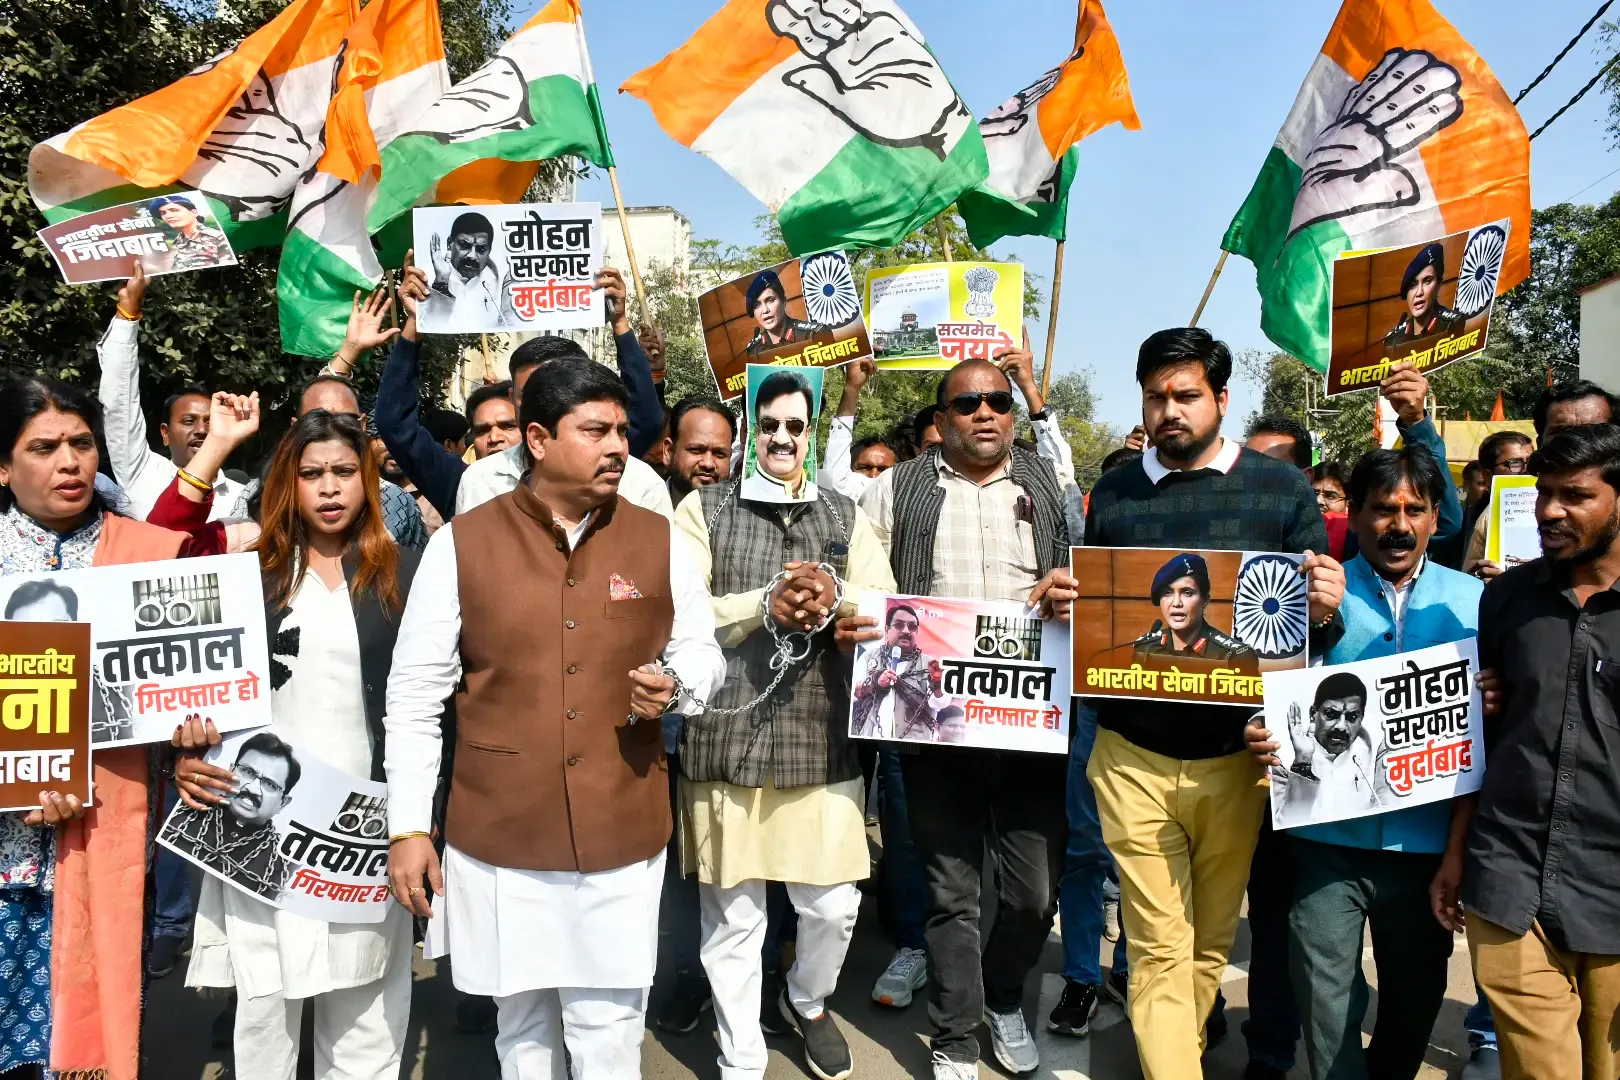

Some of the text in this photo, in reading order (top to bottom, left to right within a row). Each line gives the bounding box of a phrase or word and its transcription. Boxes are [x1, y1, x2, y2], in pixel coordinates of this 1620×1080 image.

[56, 223, 118, 244] भारतीय
[60, 233, 169, 264] जिंदाबाद
[504, 210, 593, 251] मोहन
[510, 253, 591, 278] सरकार
[511, 279, 592, 318] मुर्दाबाद
[937, 320, 996, 337] सत्यमेव
[803, 337, 860, 367] जिंदाबाद
[1340, 357, 1403, 386] भारती
[1434, 329, 1481, 363] जिंदाबाद
[96, 627, 245, 683] तत्काल
[135, 670, 260, 715] गिरफ्तार हो
[942, 660, 1057, 701] तत्काल
[1086, 664, 1264, 697] भारतीय सेना जिंदाब
[1380, 659, 1470, 711] मोहन
[964, 700, 1062, 730] गिरफ्तार हो
[1385, 701, 1470, 746] सरकार
[1386, 739, 1473, 792] मुर्दाबाद
[290, 868, 375, 903] गिरफ्तार
